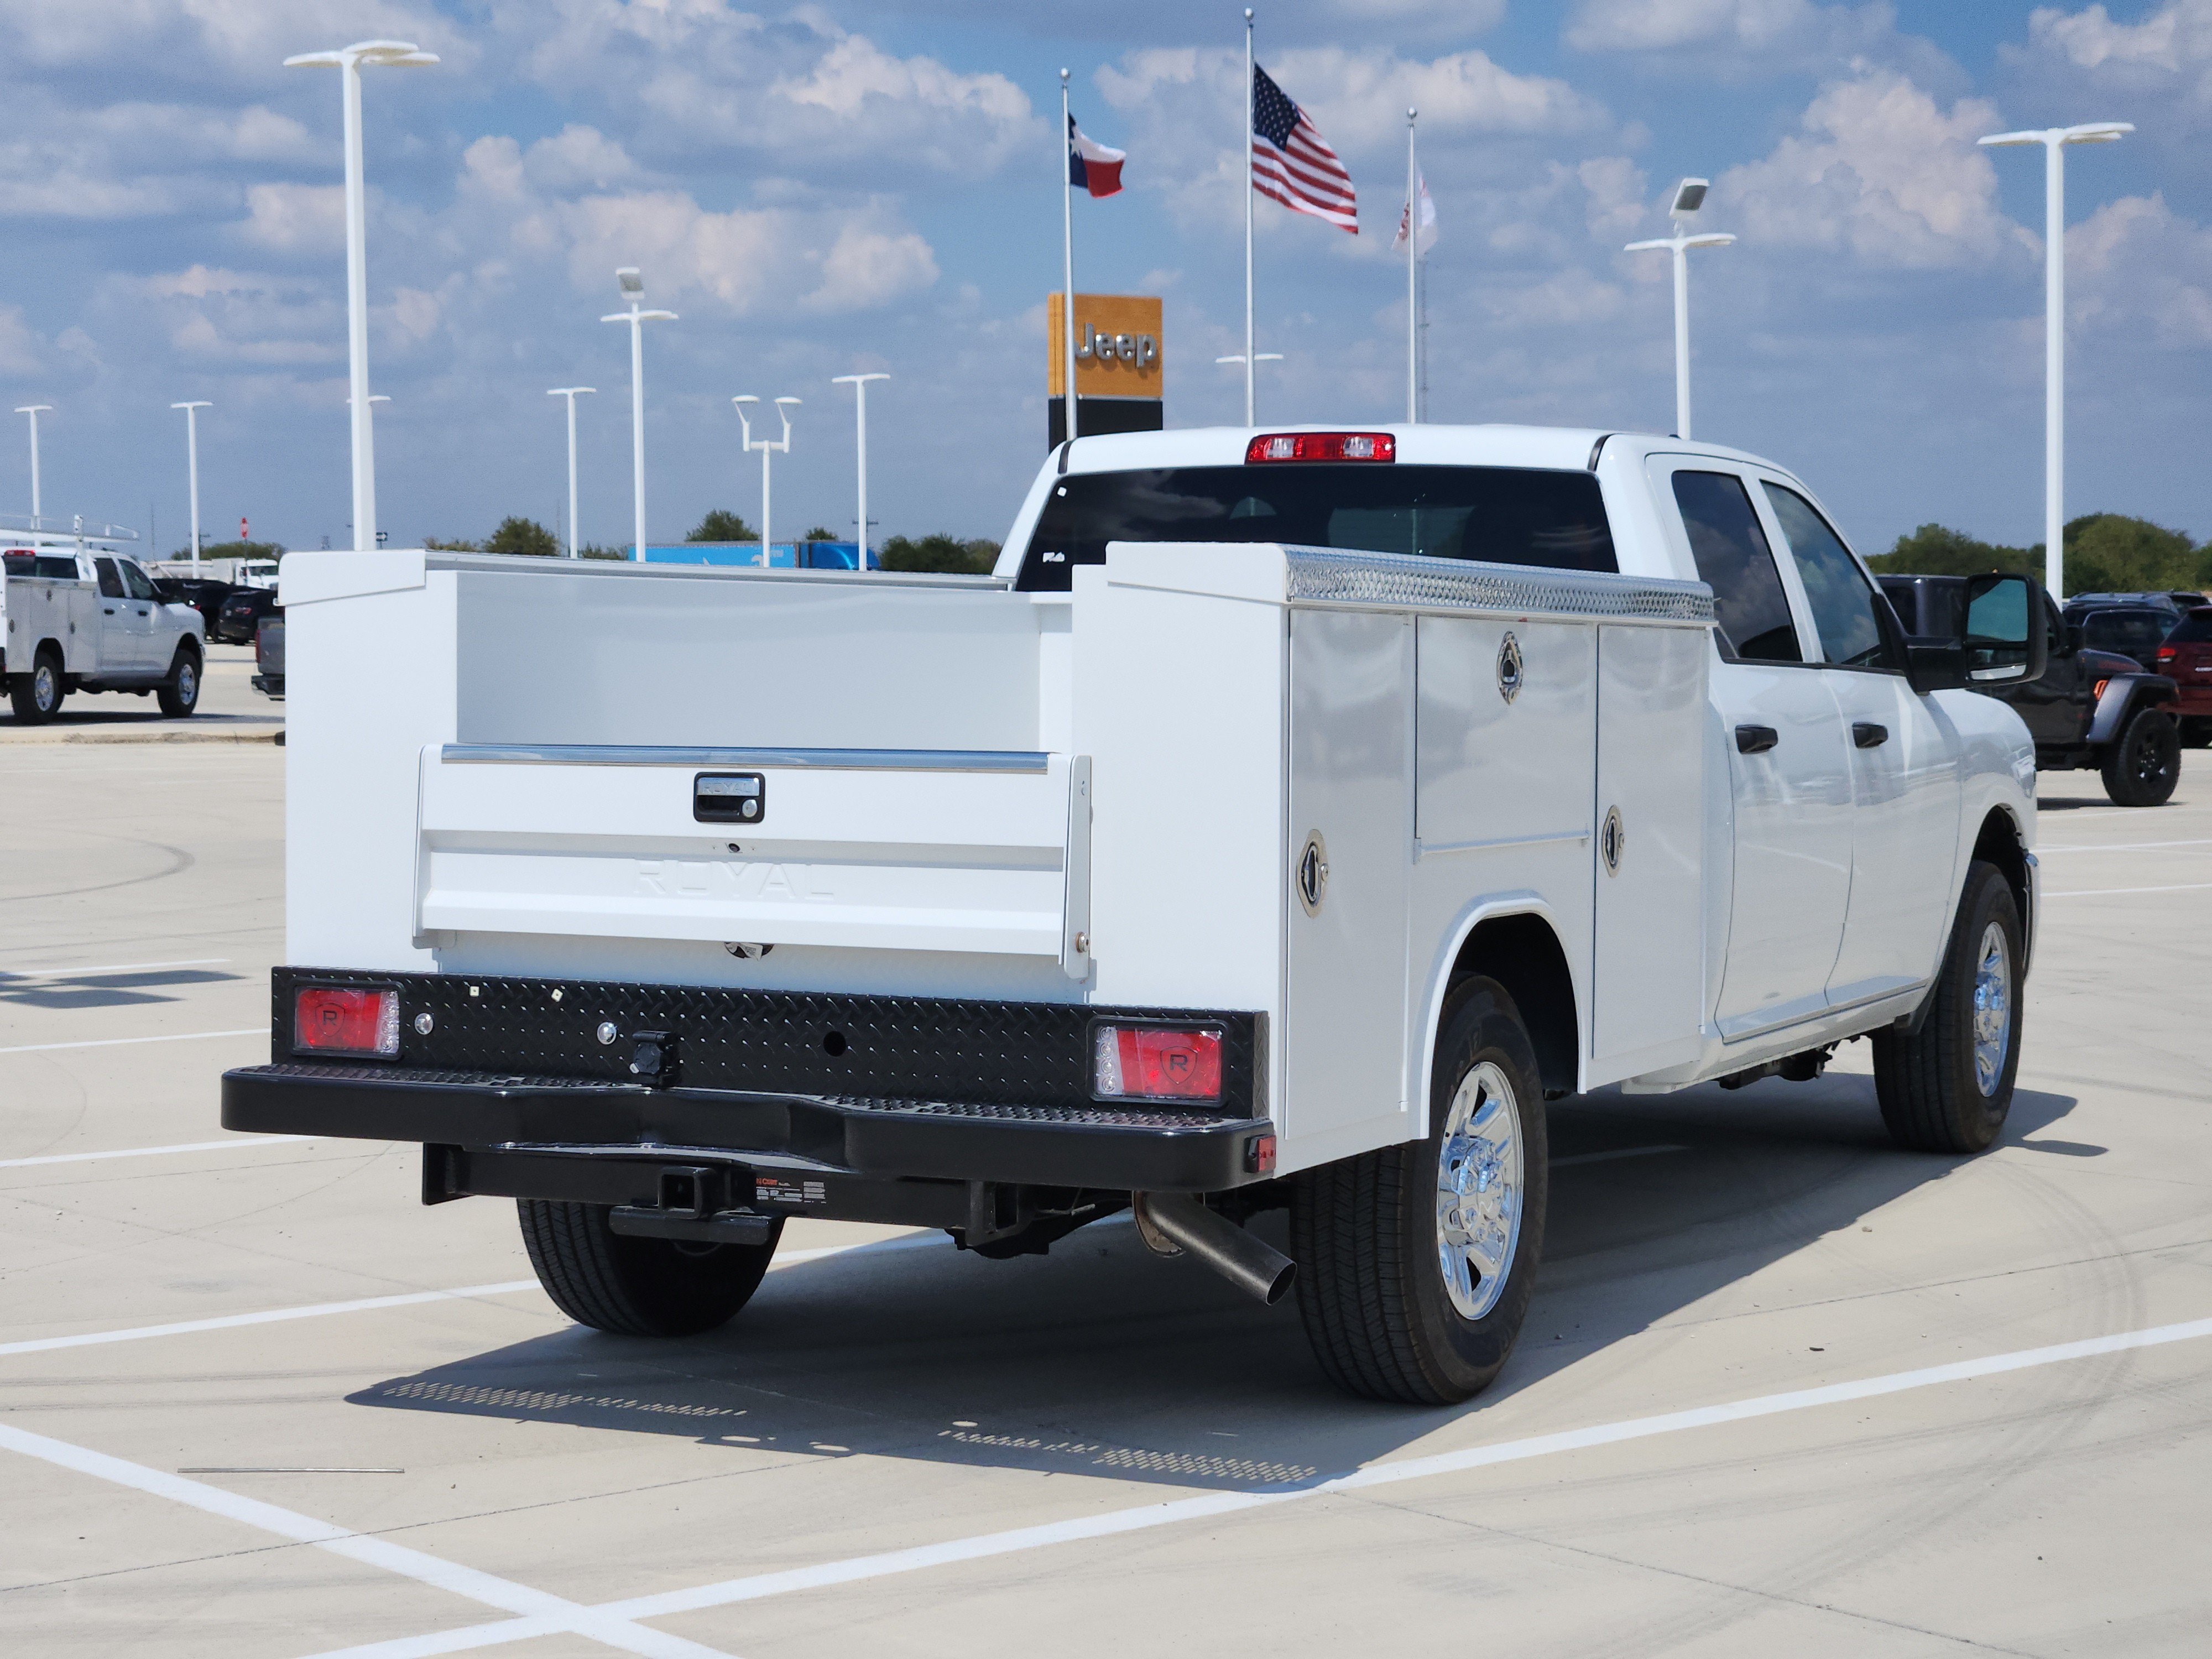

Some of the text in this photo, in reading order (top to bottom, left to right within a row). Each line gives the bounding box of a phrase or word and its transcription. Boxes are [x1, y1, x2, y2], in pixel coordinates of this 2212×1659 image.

[1075, 322, 1157, 368] Jeep
[633, 859, 834, 900] ROYAL
[323, 1010, 337, 1025] R
[1170, 1054, 1188, 1072] R
